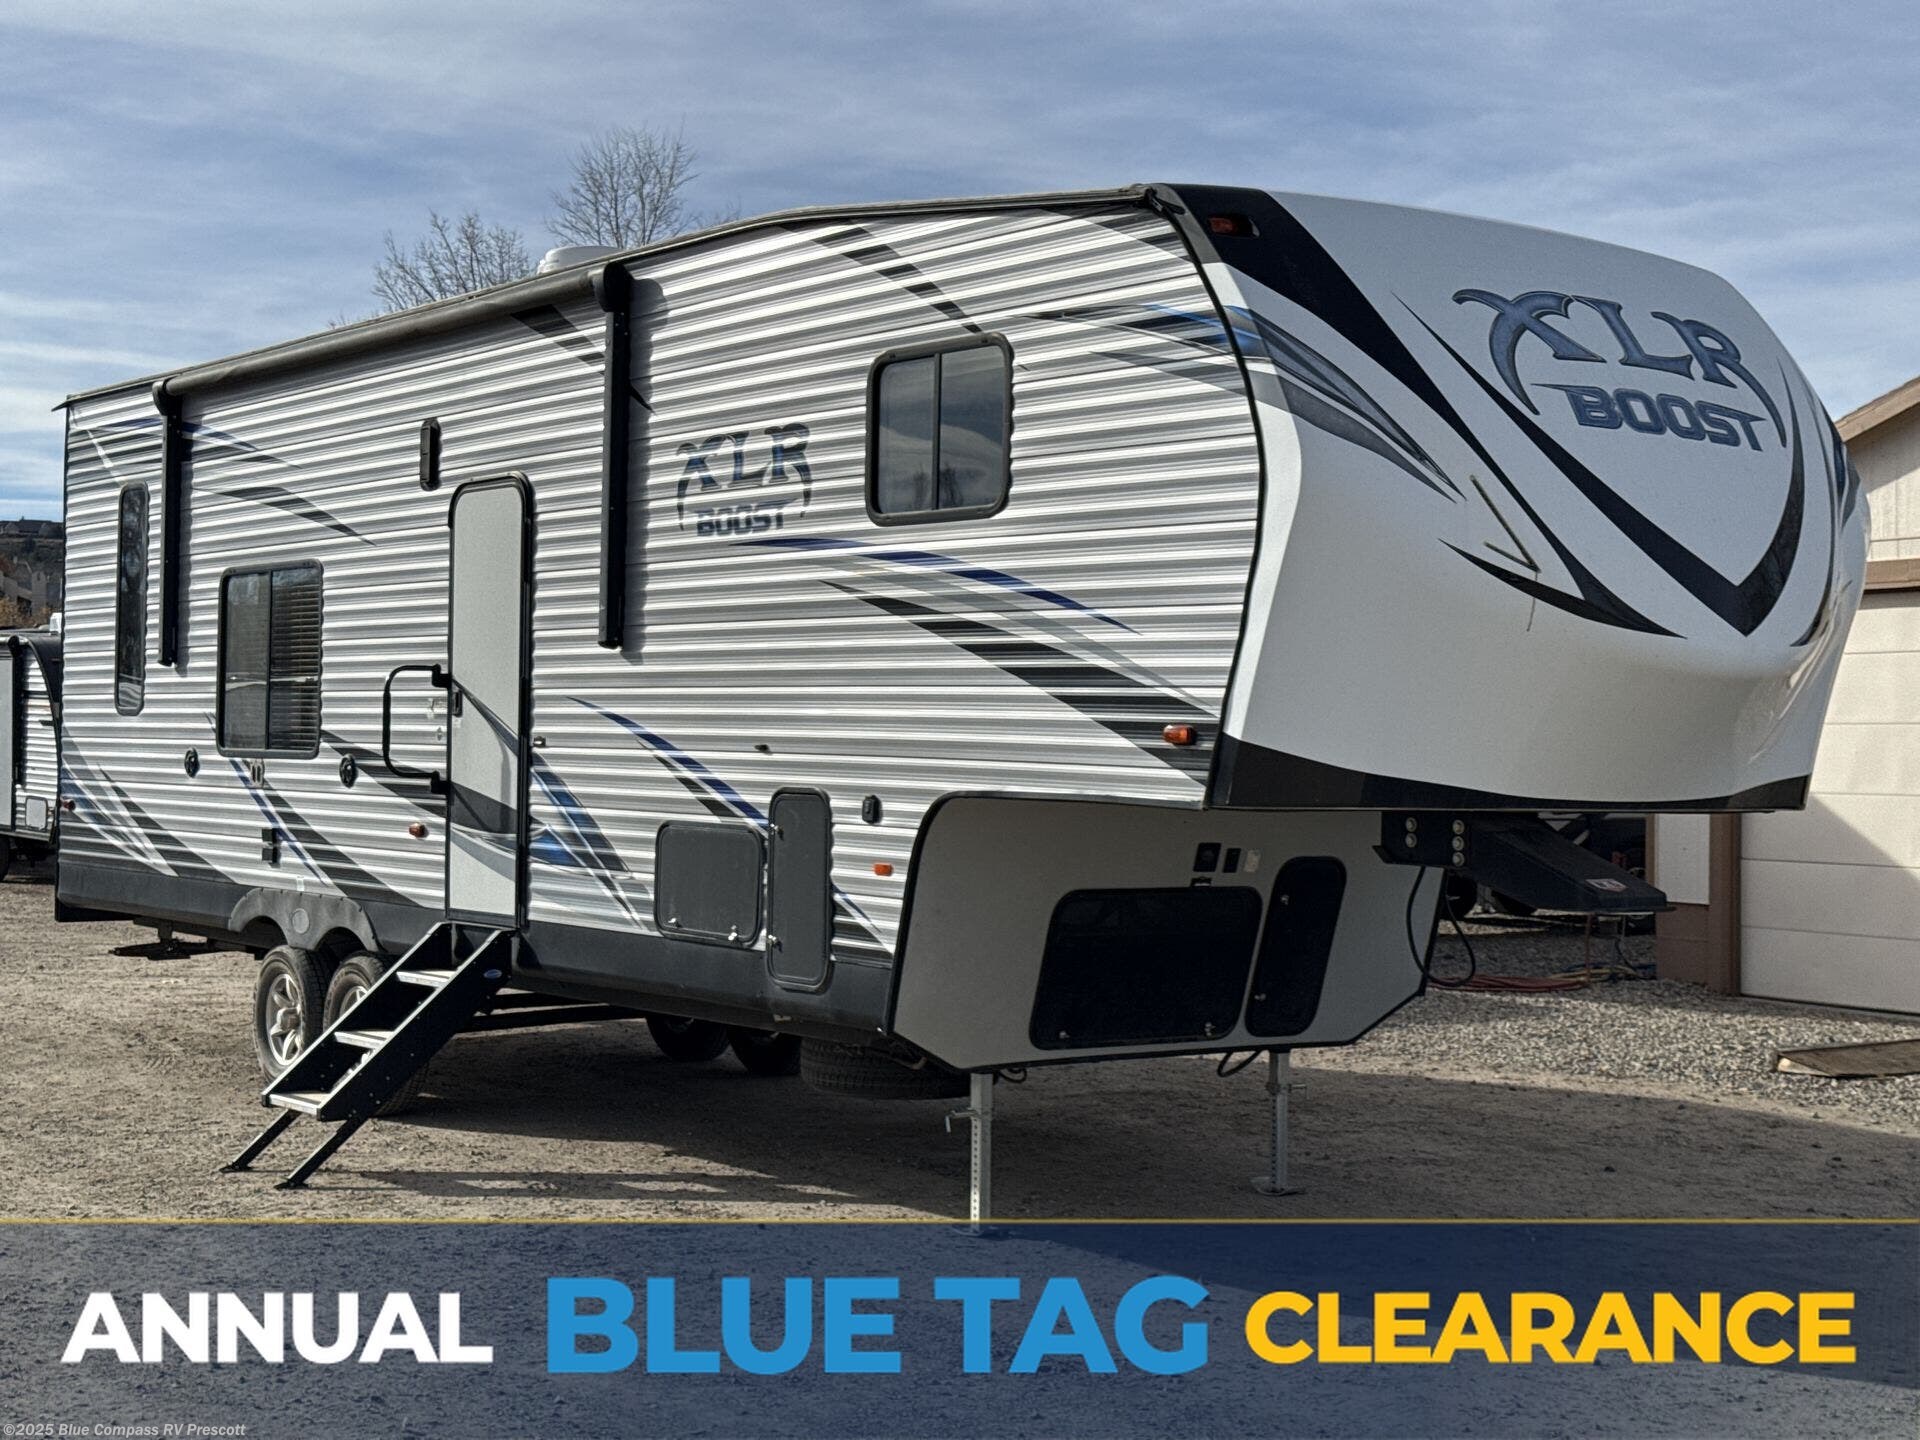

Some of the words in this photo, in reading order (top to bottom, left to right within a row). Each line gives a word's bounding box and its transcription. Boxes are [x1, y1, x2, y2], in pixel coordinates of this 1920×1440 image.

[1452, 289, 1787, 448] XLR
[1531, 383, 1767, 451] BOOST
[676, 422, 812, 531] XLR
[692, 498, 798, 537] BOOST
